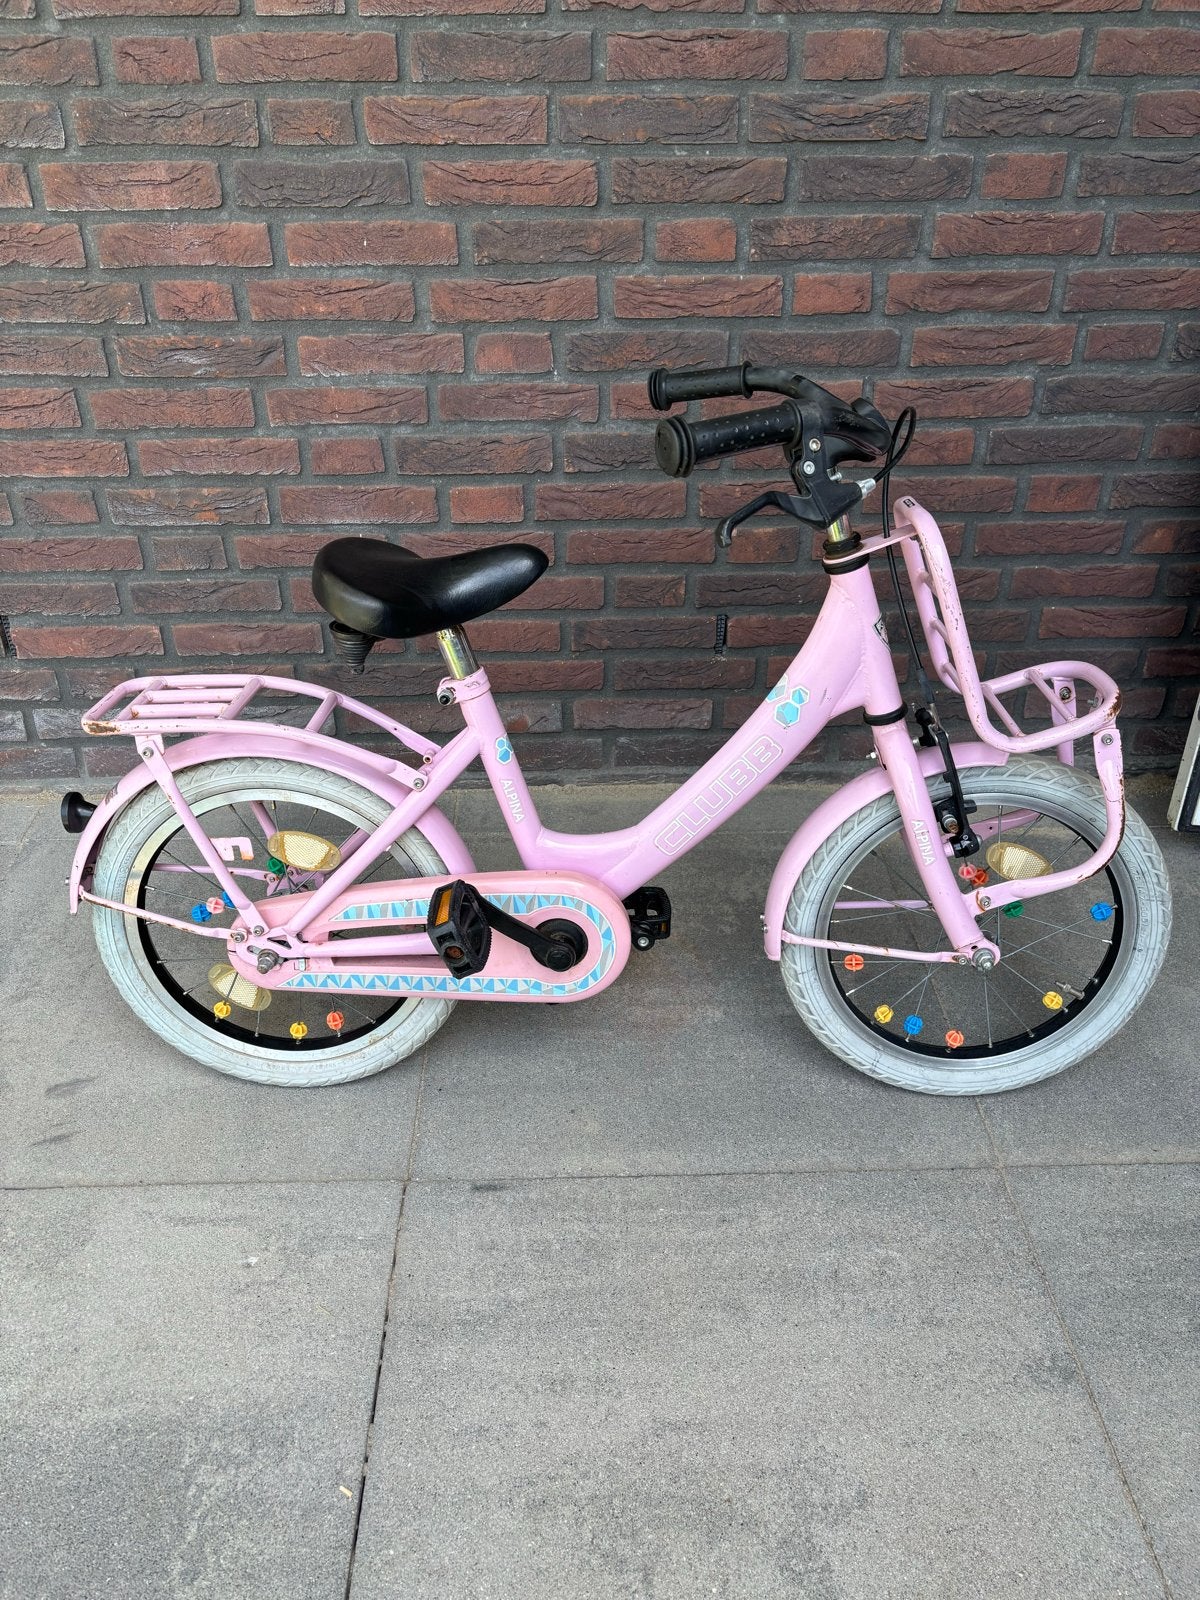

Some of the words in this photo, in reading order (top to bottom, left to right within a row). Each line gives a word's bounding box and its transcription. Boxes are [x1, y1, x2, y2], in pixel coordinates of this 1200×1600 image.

[501, 779, 525, 823] ALPINA
[654, 735, 783, 856] CLUBB
[911, 820, 936, 866] ALPINA
